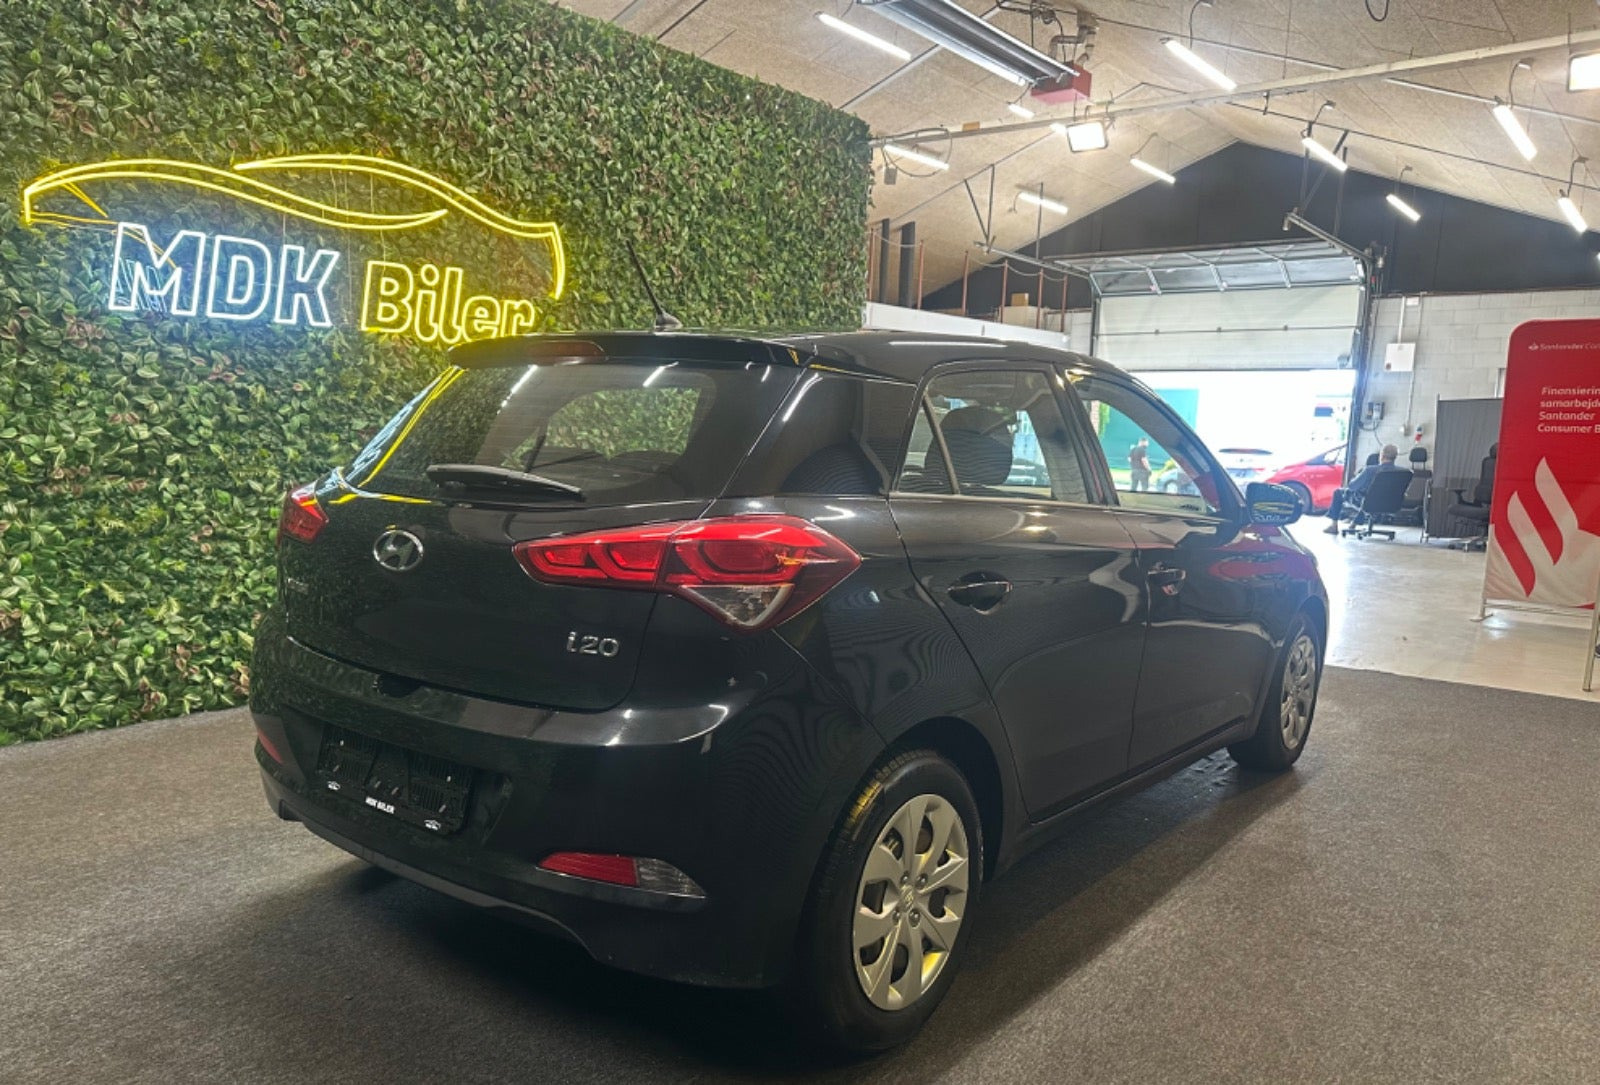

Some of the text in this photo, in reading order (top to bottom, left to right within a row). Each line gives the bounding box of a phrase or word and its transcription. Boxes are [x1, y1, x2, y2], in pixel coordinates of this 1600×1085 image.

[108, 222, 535, 343] MDK Biler
[1539, 411, 1595, 420] Santander
[1537, 423, 1592, 432] Consumer
[566, 631, 620, 657] i20
